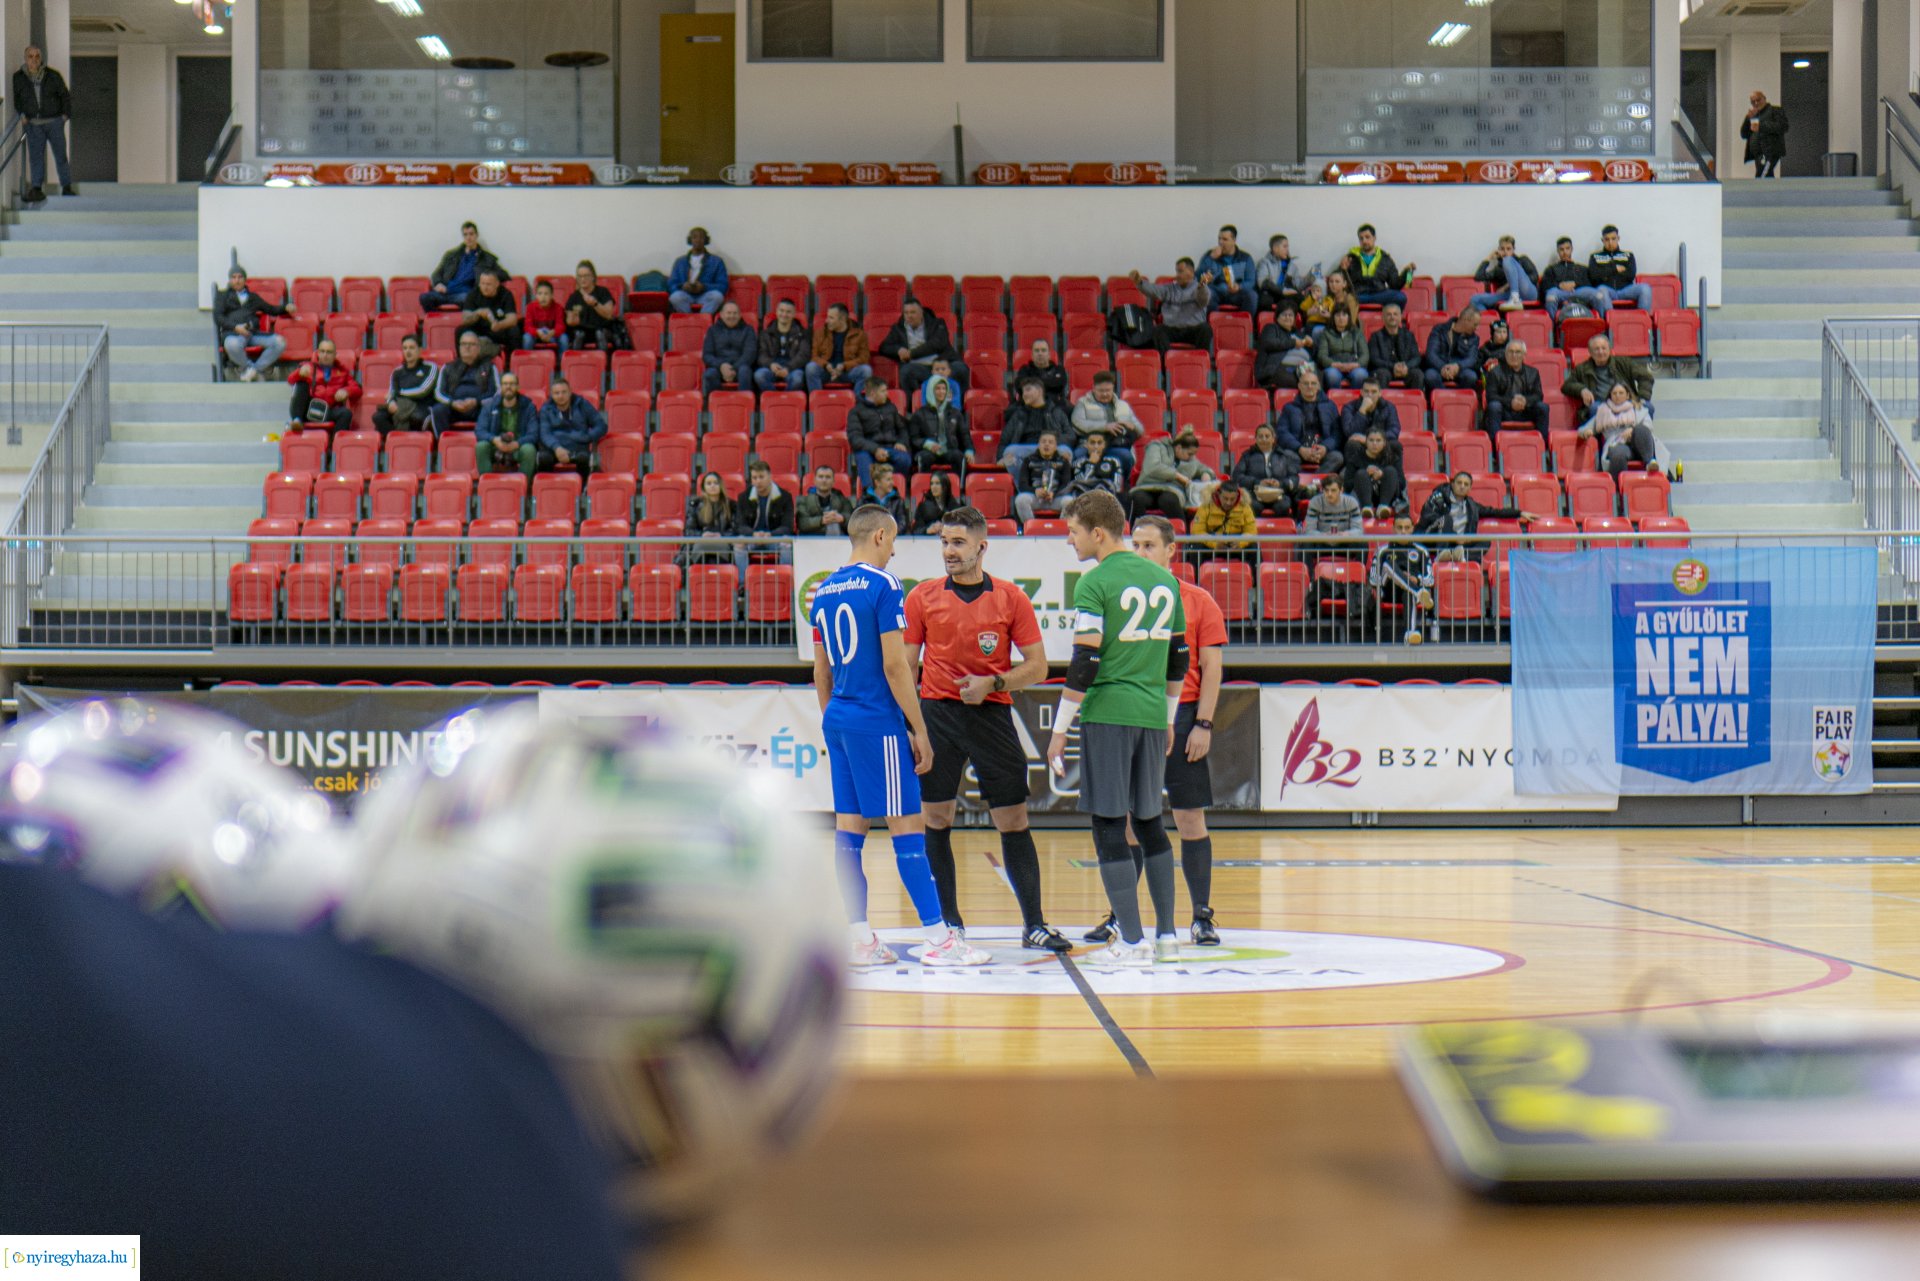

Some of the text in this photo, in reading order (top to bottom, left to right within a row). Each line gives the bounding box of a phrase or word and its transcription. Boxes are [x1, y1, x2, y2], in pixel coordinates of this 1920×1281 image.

[1396, 162, 1448, 172] Bige Holding
[1117, 585, 1176, 642] 22
[1635, 607, 1749, 634] A GYŰLÖLET
[815, 602, 859, 667] 10
[1635, 636, 1749, 696] NEM
[1636, 696, 1749, 742] PÁLYA!
[1815, 710, 1853, 725] FAIR
[1815, 726, 1853, 740] PLAY
